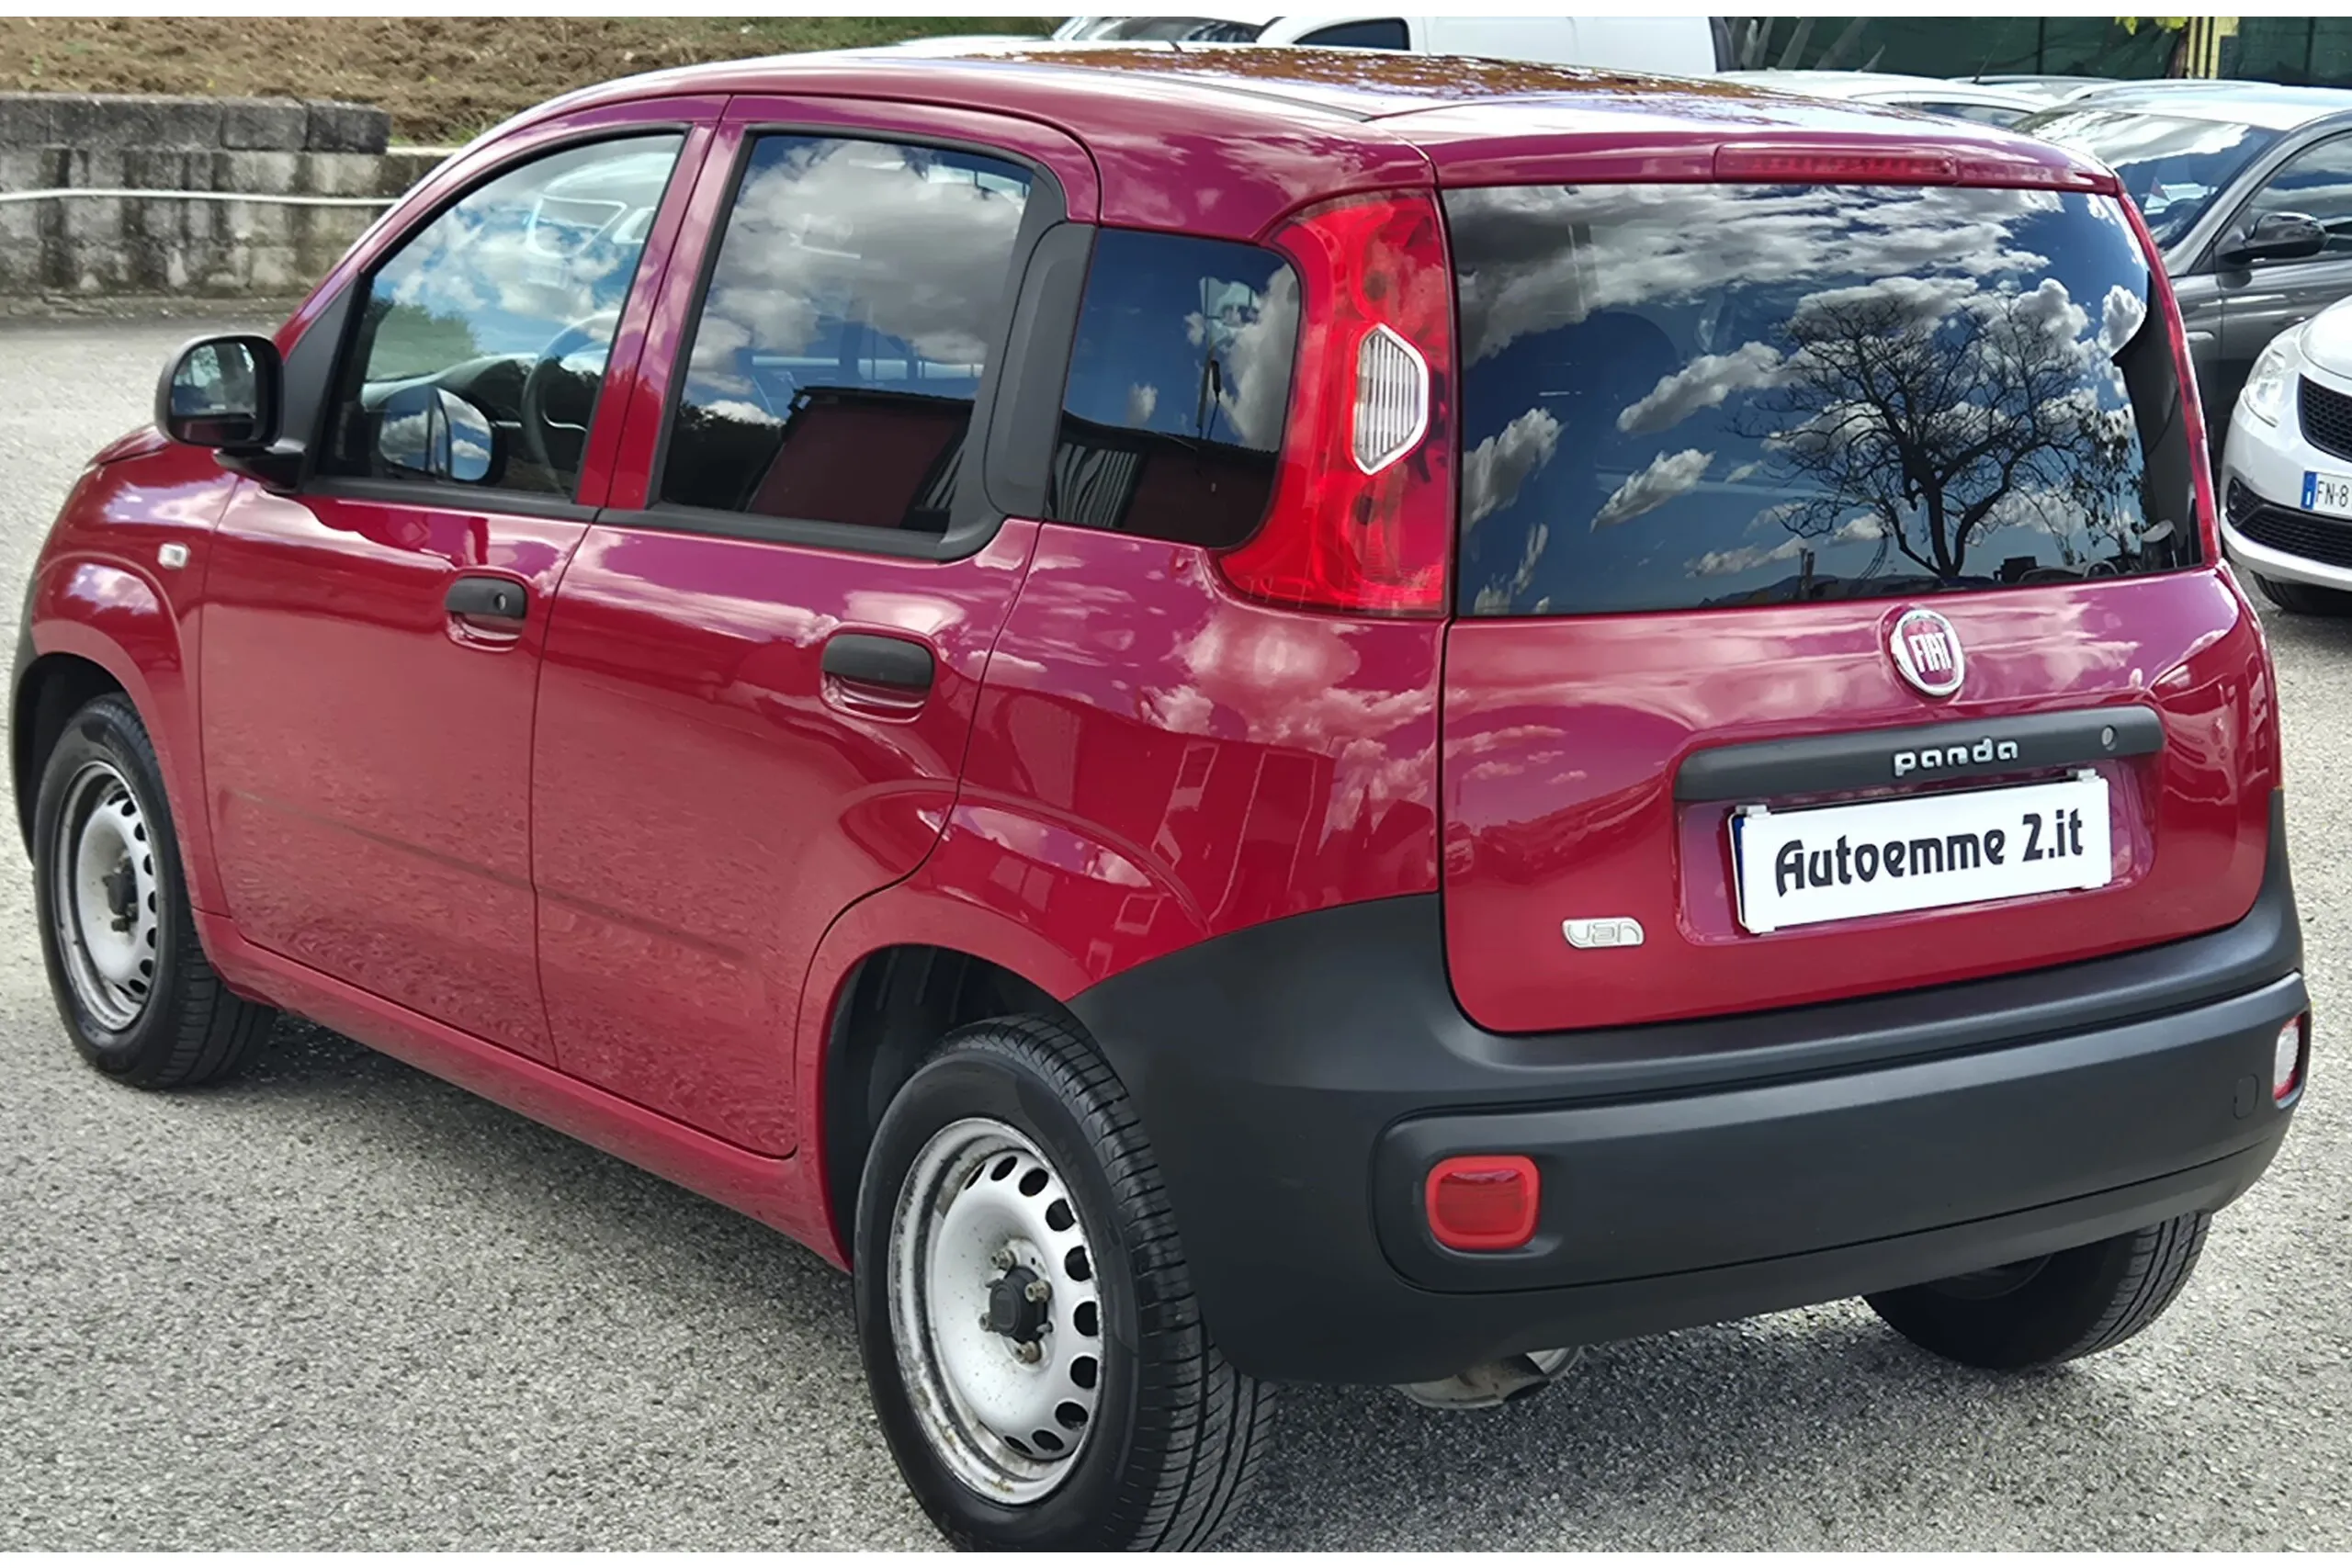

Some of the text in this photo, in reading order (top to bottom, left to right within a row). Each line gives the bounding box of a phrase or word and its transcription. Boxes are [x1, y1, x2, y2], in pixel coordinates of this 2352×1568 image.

[1908, 632, 1952, 672] FIAT
[1894, 738, 2018, 776] panda
[1775, 807, 2084, 897] Autoemme 2.it
